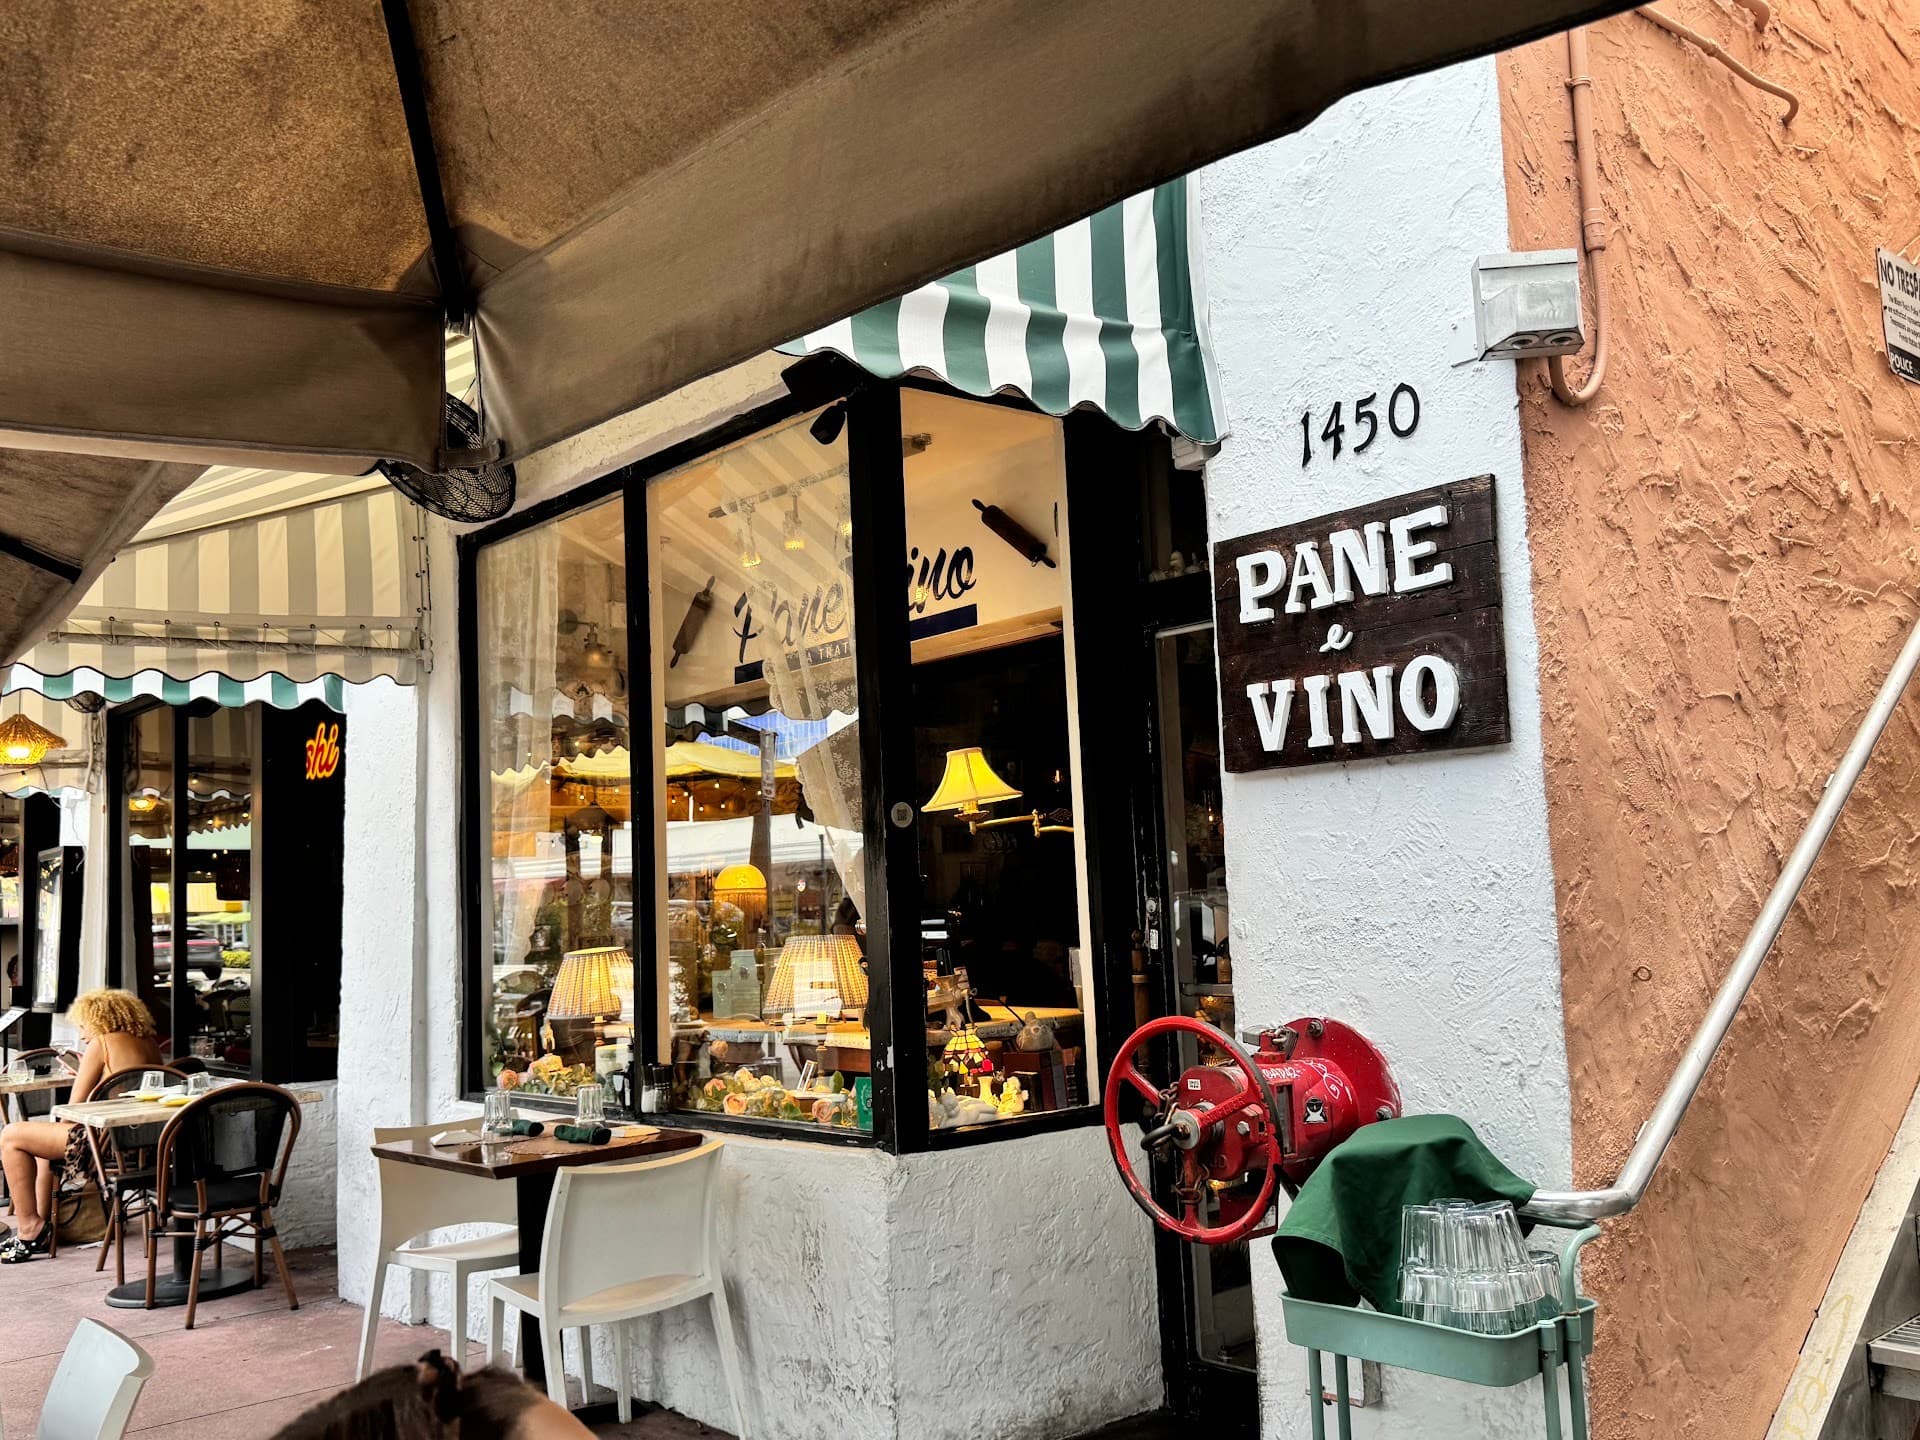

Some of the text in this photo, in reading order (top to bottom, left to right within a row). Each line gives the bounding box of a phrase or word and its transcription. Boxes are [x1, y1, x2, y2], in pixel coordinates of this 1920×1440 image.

[1879, 256, 1895, 287] NO
[1890, 351, 1914, 375] POLICE
[1301, 382, 1421, 468] 1450
[1235, 505, 1453, 624] PANE
[1319, 623, 1354, 653] e
[1246, 655, 1460, 752] VINO
